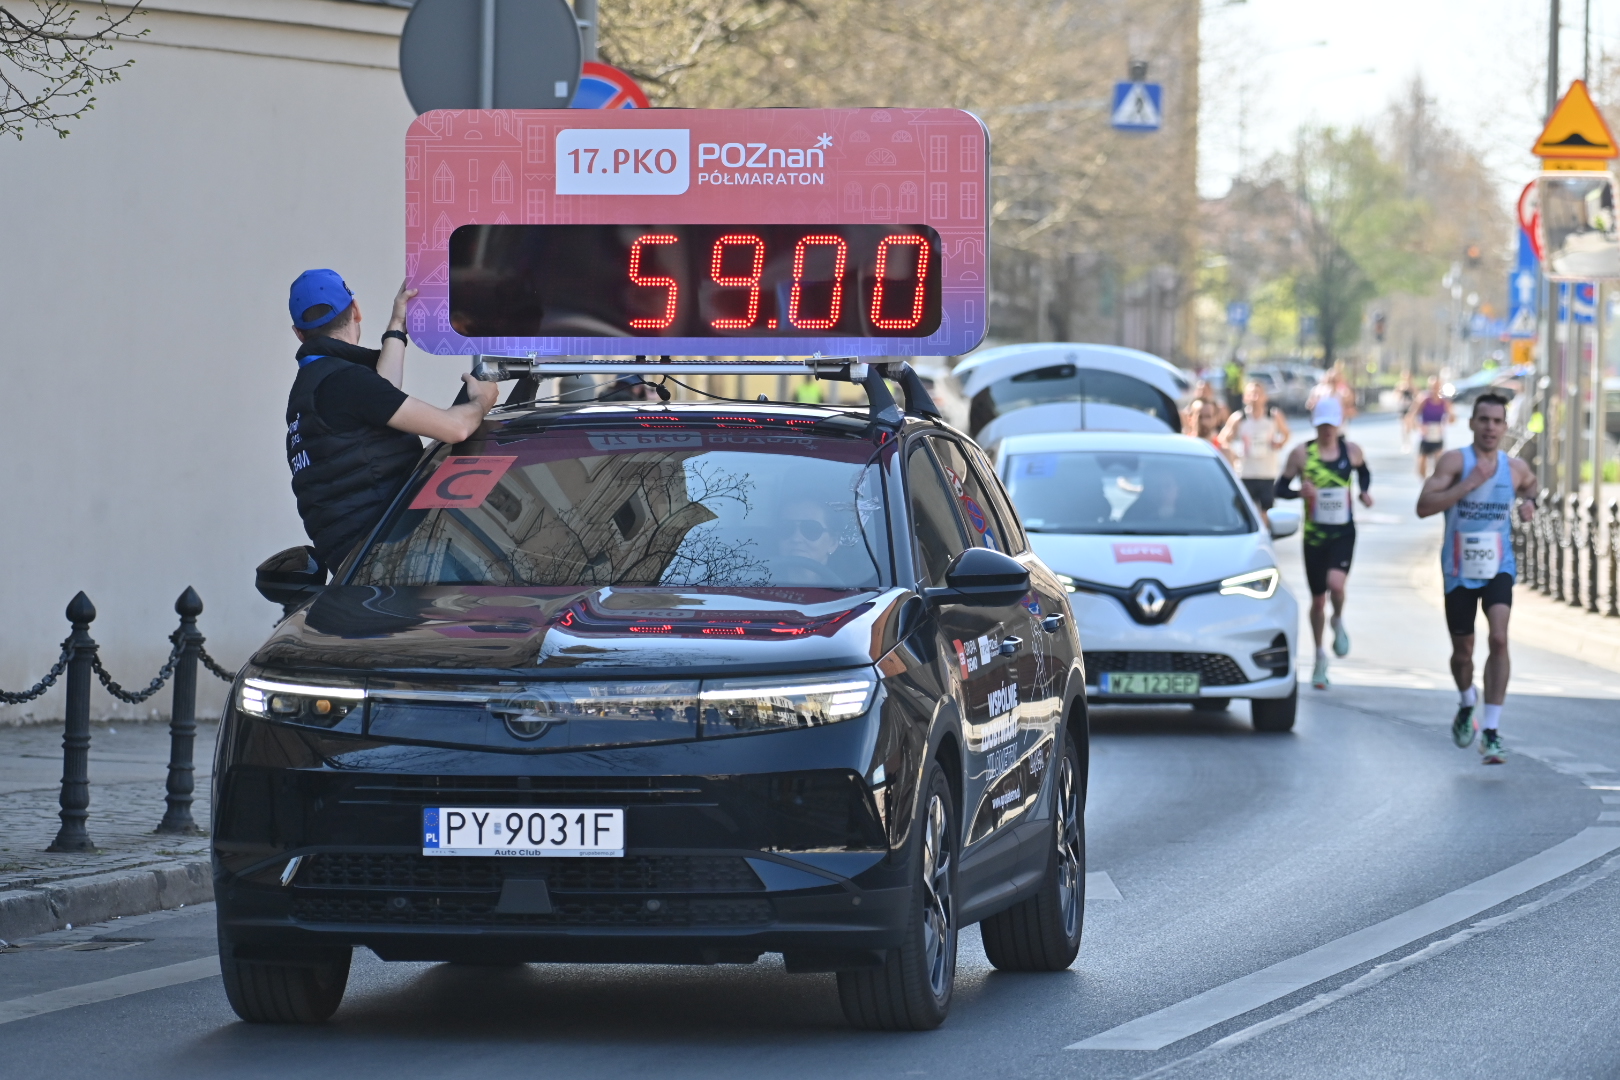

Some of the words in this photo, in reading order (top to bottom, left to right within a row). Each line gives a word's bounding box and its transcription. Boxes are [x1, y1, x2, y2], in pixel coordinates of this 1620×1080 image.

[698, 169, 824, 185] PÓŁMARATON
[629, 234, 930, 329] 59.00
[436, 469, 493, 500] C
[1143, 676, 1193, 693] 123EP
[426, 833, 438, 843] PL
[446, 811, 490, 845] PY
[505, 812, 614, 846] 9031F
